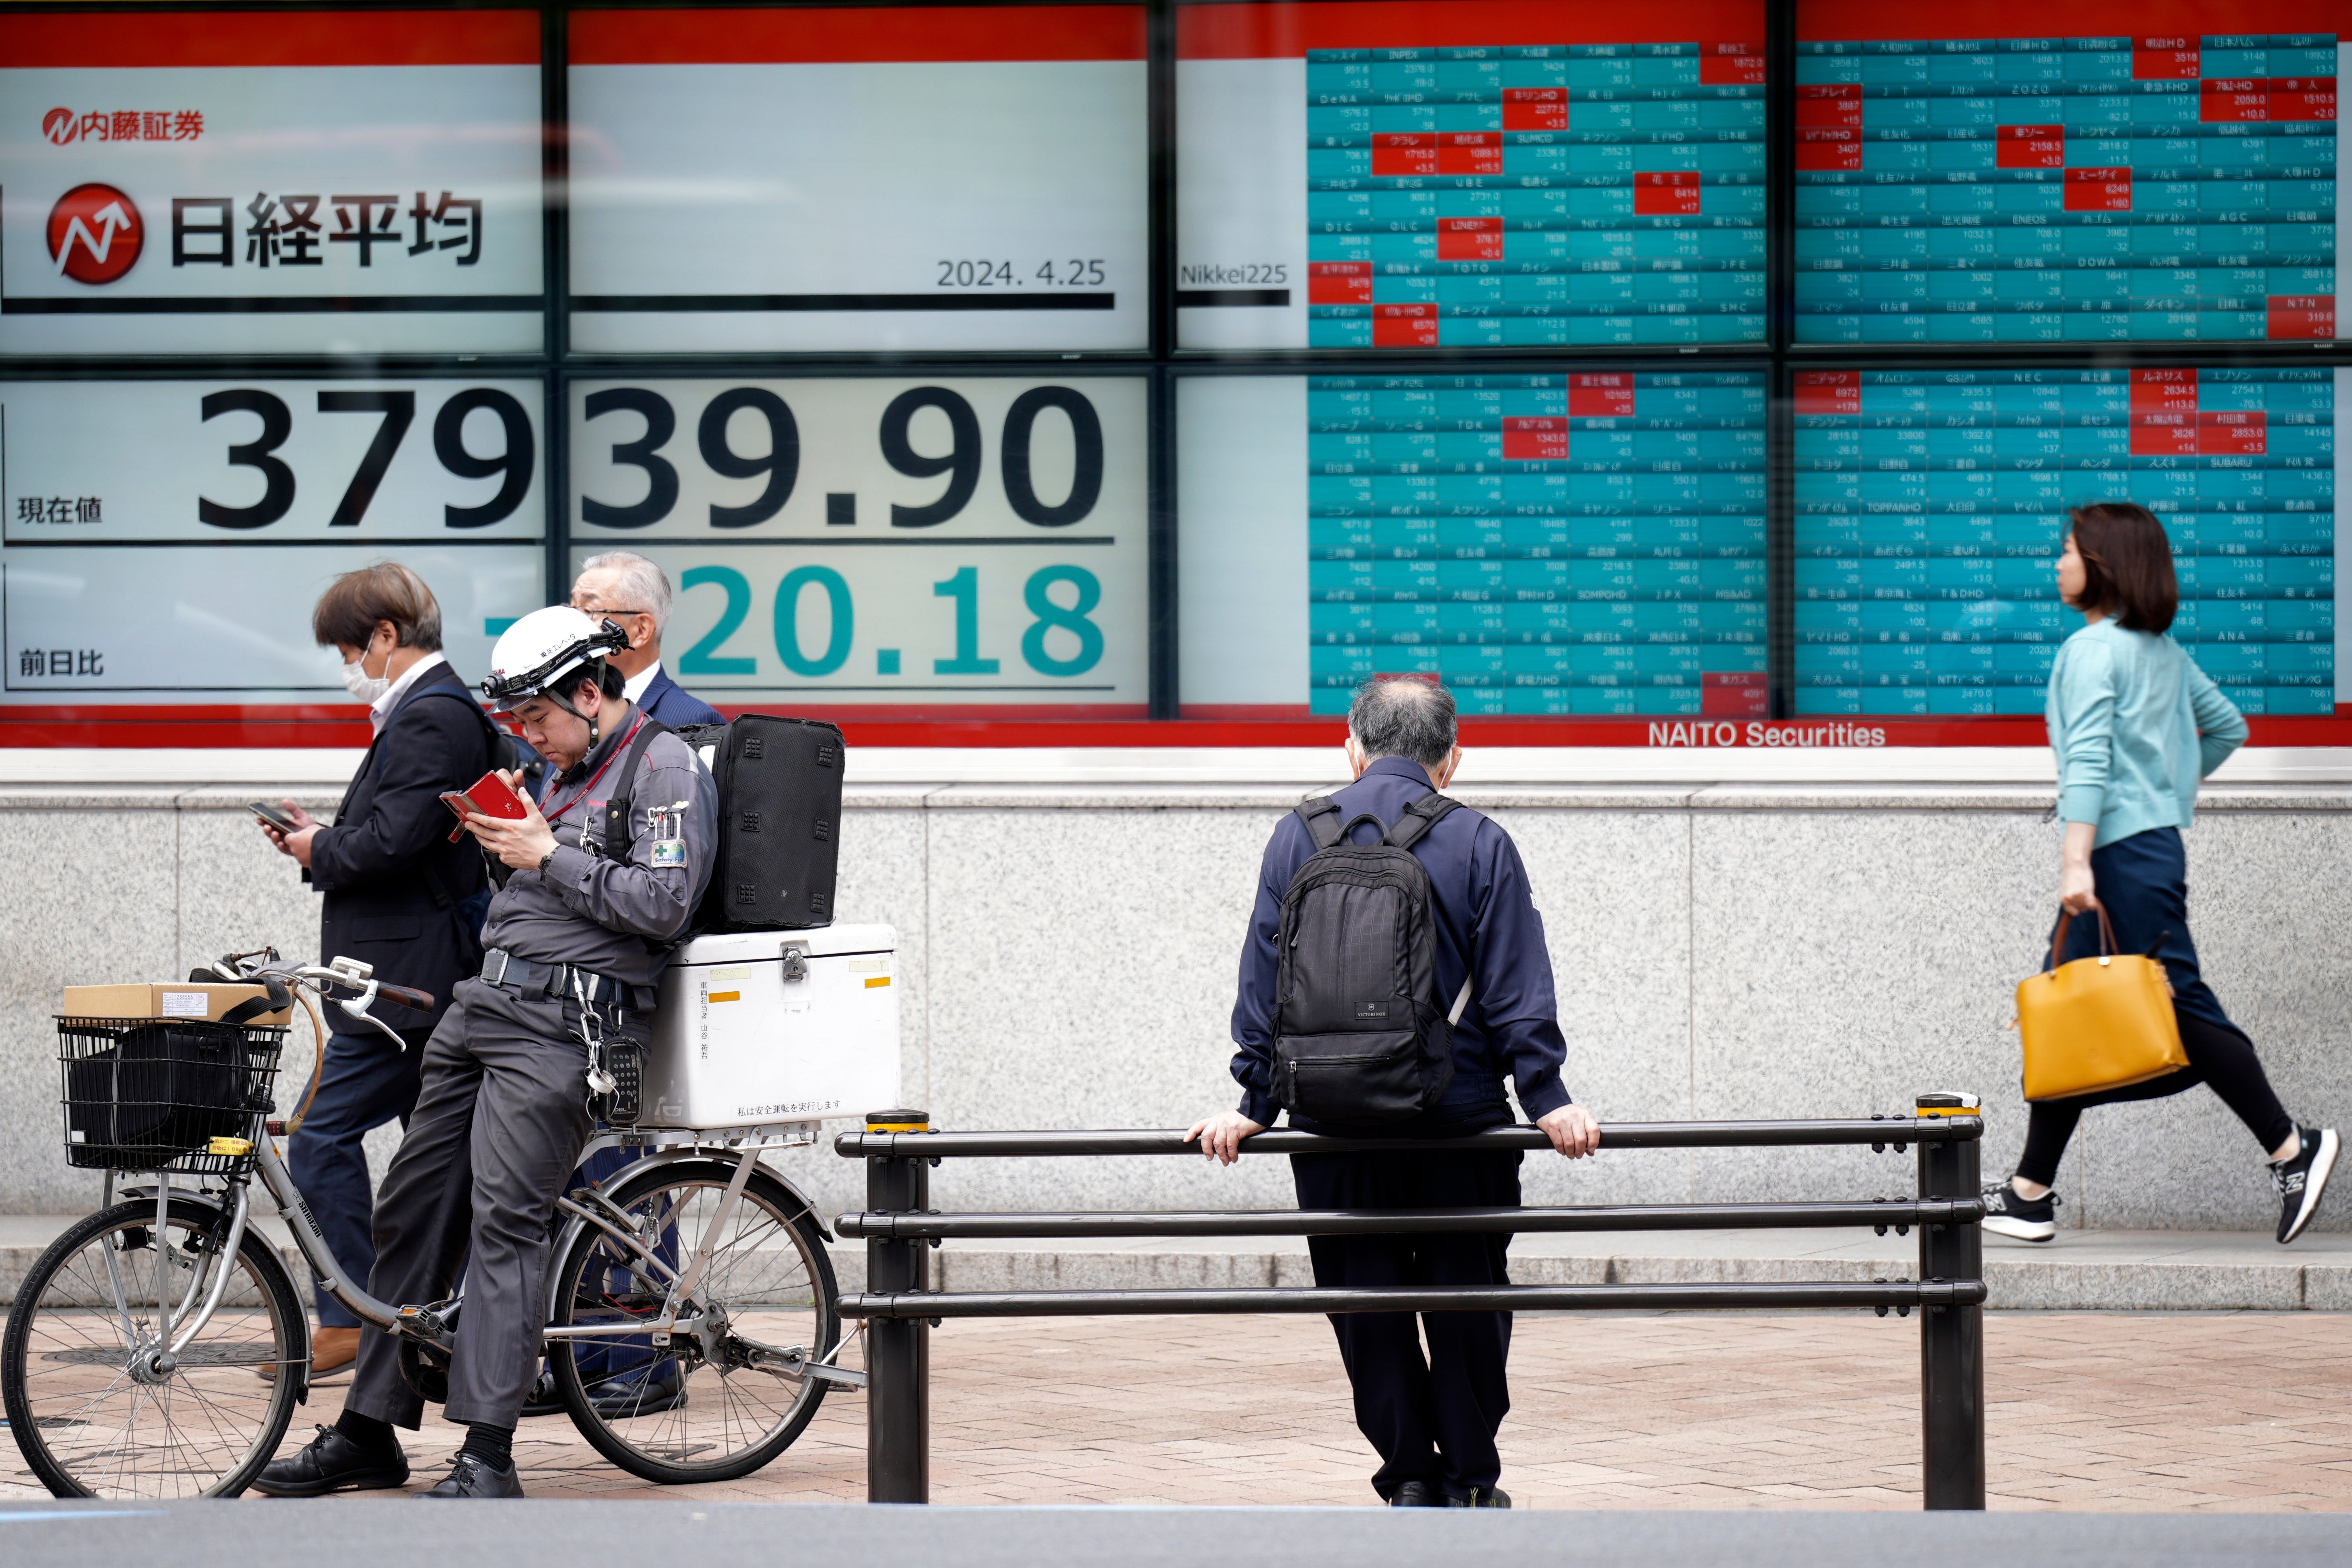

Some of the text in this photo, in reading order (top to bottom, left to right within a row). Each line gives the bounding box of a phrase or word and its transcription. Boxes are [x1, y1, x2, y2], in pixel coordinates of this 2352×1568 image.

[81, 110, 204, 141] 内藤証券
[170, 191, 482, 268] 日経平均
[1036, 260, 1106, 286] 4.25
[1181, 263, 1287, 285] Nikkei225
[17, 496, 102, 524] 現在値
[19, 648, 104, 677] 前日比
[1649, 722, 1885, 747] NAITO Securities
[606, 749, 621, 765] TOSHIBA
[571, 789, 589, 805] TOSHIBA
[701, 1025, 708, 1040] 山谷
[701, 1044, 708, 1059] 祐吾
[737, 1099, 840, 1116] 私は安全運転を実行します
